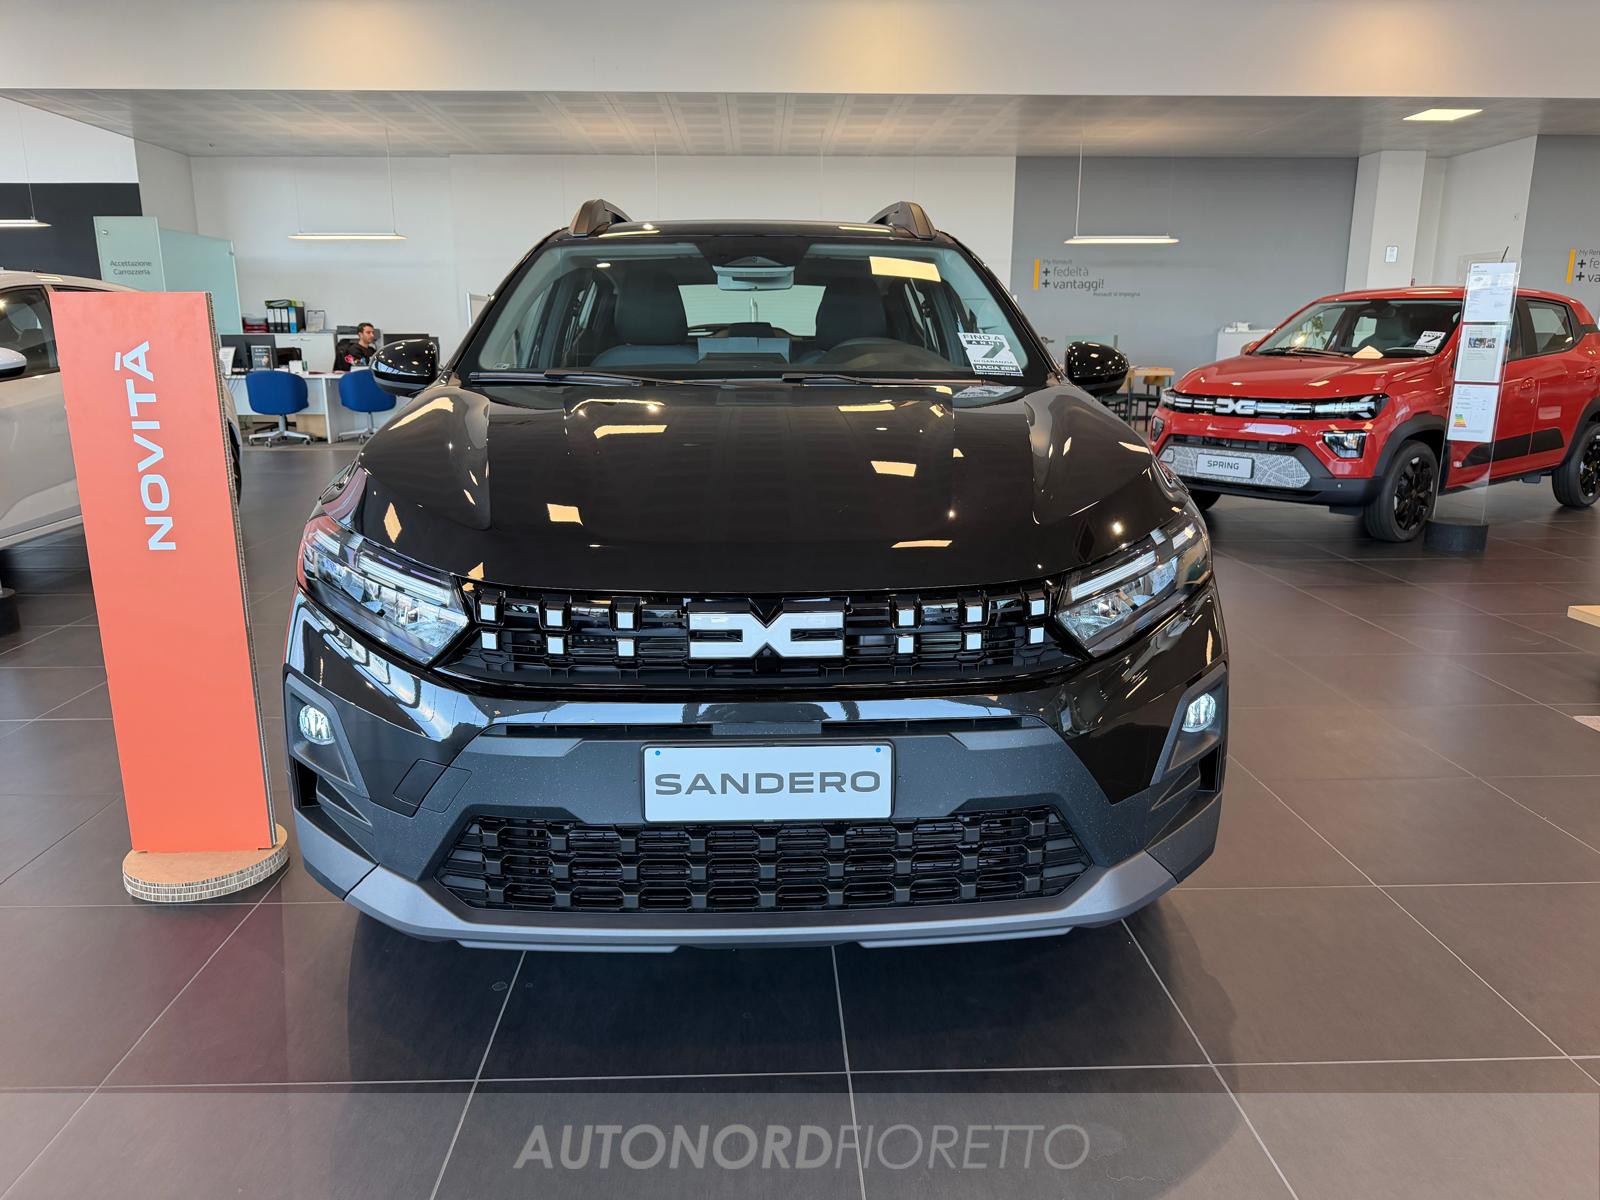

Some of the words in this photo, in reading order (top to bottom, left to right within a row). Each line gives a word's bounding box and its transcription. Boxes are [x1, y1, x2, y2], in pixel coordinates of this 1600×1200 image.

[112, 268, 151, 276] Carrozzeria
[1053, 265, 1089, 277] fedeltà
[1052, 278, 1105, 292] vantaggi!
[962, 333, 991, 341] FINO
[1207, 459, 1240, 470] SPRING
[655, 770, 881, 796] SANDERO
